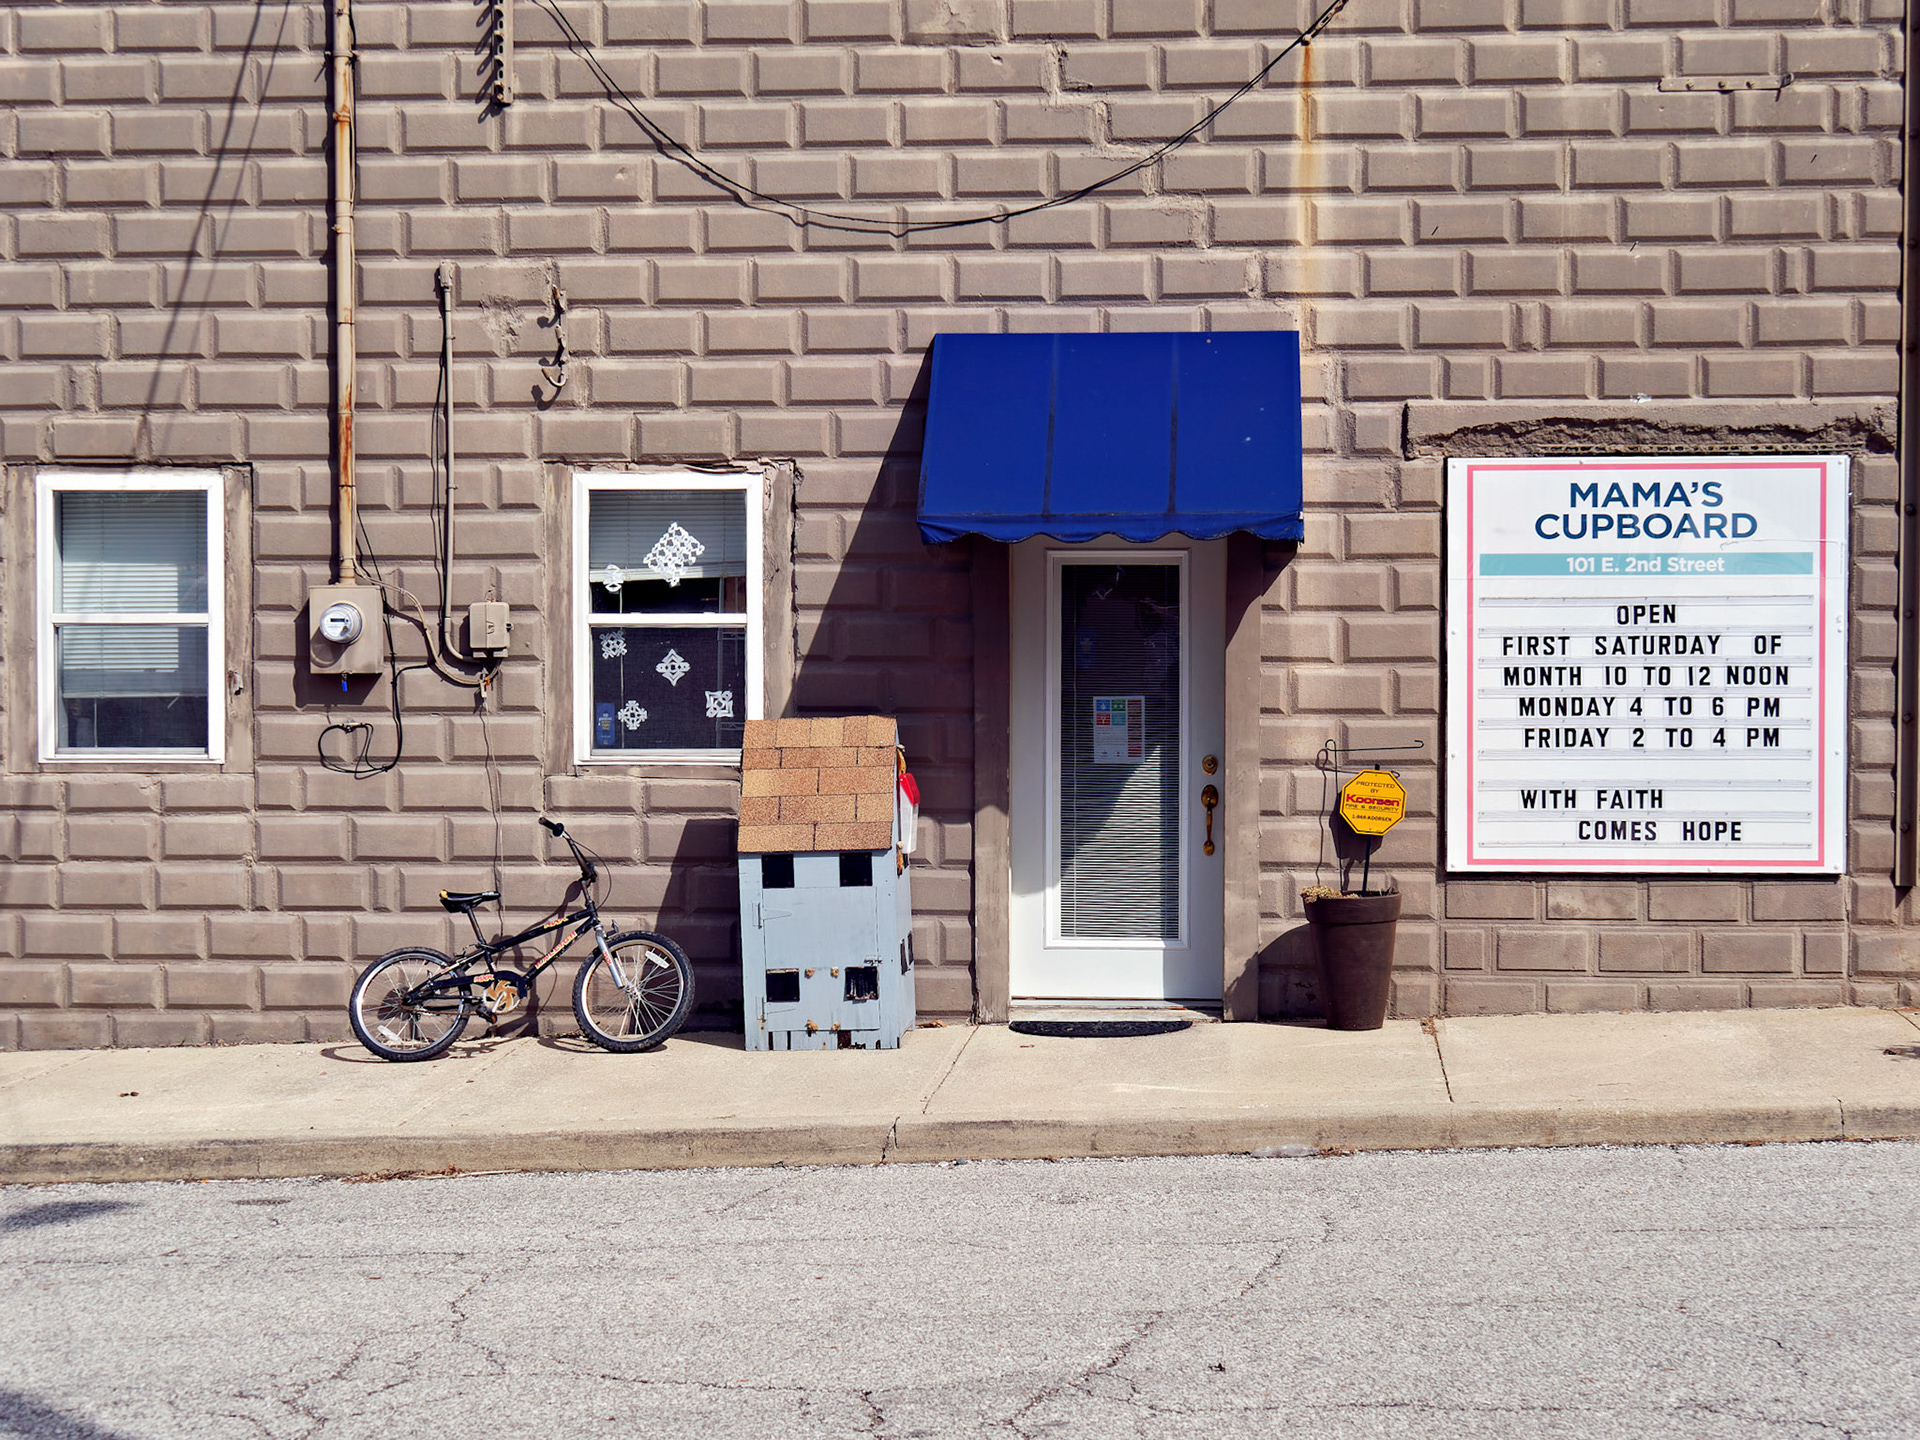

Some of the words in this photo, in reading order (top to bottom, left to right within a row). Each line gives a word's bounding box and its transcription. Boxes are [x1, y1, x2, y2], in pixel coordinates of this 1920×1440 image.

[1570, 481, 1723, 508] MAMA'S
[1535, 513, 1758, 540] CUPBOARD
[1566, 557, 1595, 573] 101
[1601, 557, 1620, 573] E.
[1624, 556, 1662, 573] 2nd
[1667, 556, 1726, 573] Street
[1616, 604, 1676, 625] OPEN
[1503, 635, 1571, 656] FIRST
[1595, 634, 1721, 656] SATURDAY
[1754, 634, 1782, 655] OF
[1503, 666, 1582, 686] MONTH
[1605, 665, 1627, 686] 10
[1643, 665, 1671, 686] TO
[1688, 665, 1711, 686] 12
[1726, 665, 1789, 686] NOON
[1519, 696, 1616, 717] MONDAY
[1629, 696, 1643, 717] 4
[1664, 696, 1692, 717] TO
[1712, 696, 1724, 716] 6
[1747, 697, 1780, 718] PM
[1524, 727, 1610, 748] FRIDAY
[1632, 727, 1645, 748] 2
[1665, 727, 1693, 748] TO
[1712, 727, 1726, 748] 4
[1746, 727, 1780, 748] PM
[1356, 781, 1395, 789] PROTECTED
[1346, 794, 1400, 806] Koorsen
[1520, 789, 1577, 809] WITH
[1597, 789, 1663, 810] FAITH
[1578, 820, 1657, 841] COMES
[1682, 821, 1742, 841] HOPE
[535, 931, 577, 969] RALEIGH
